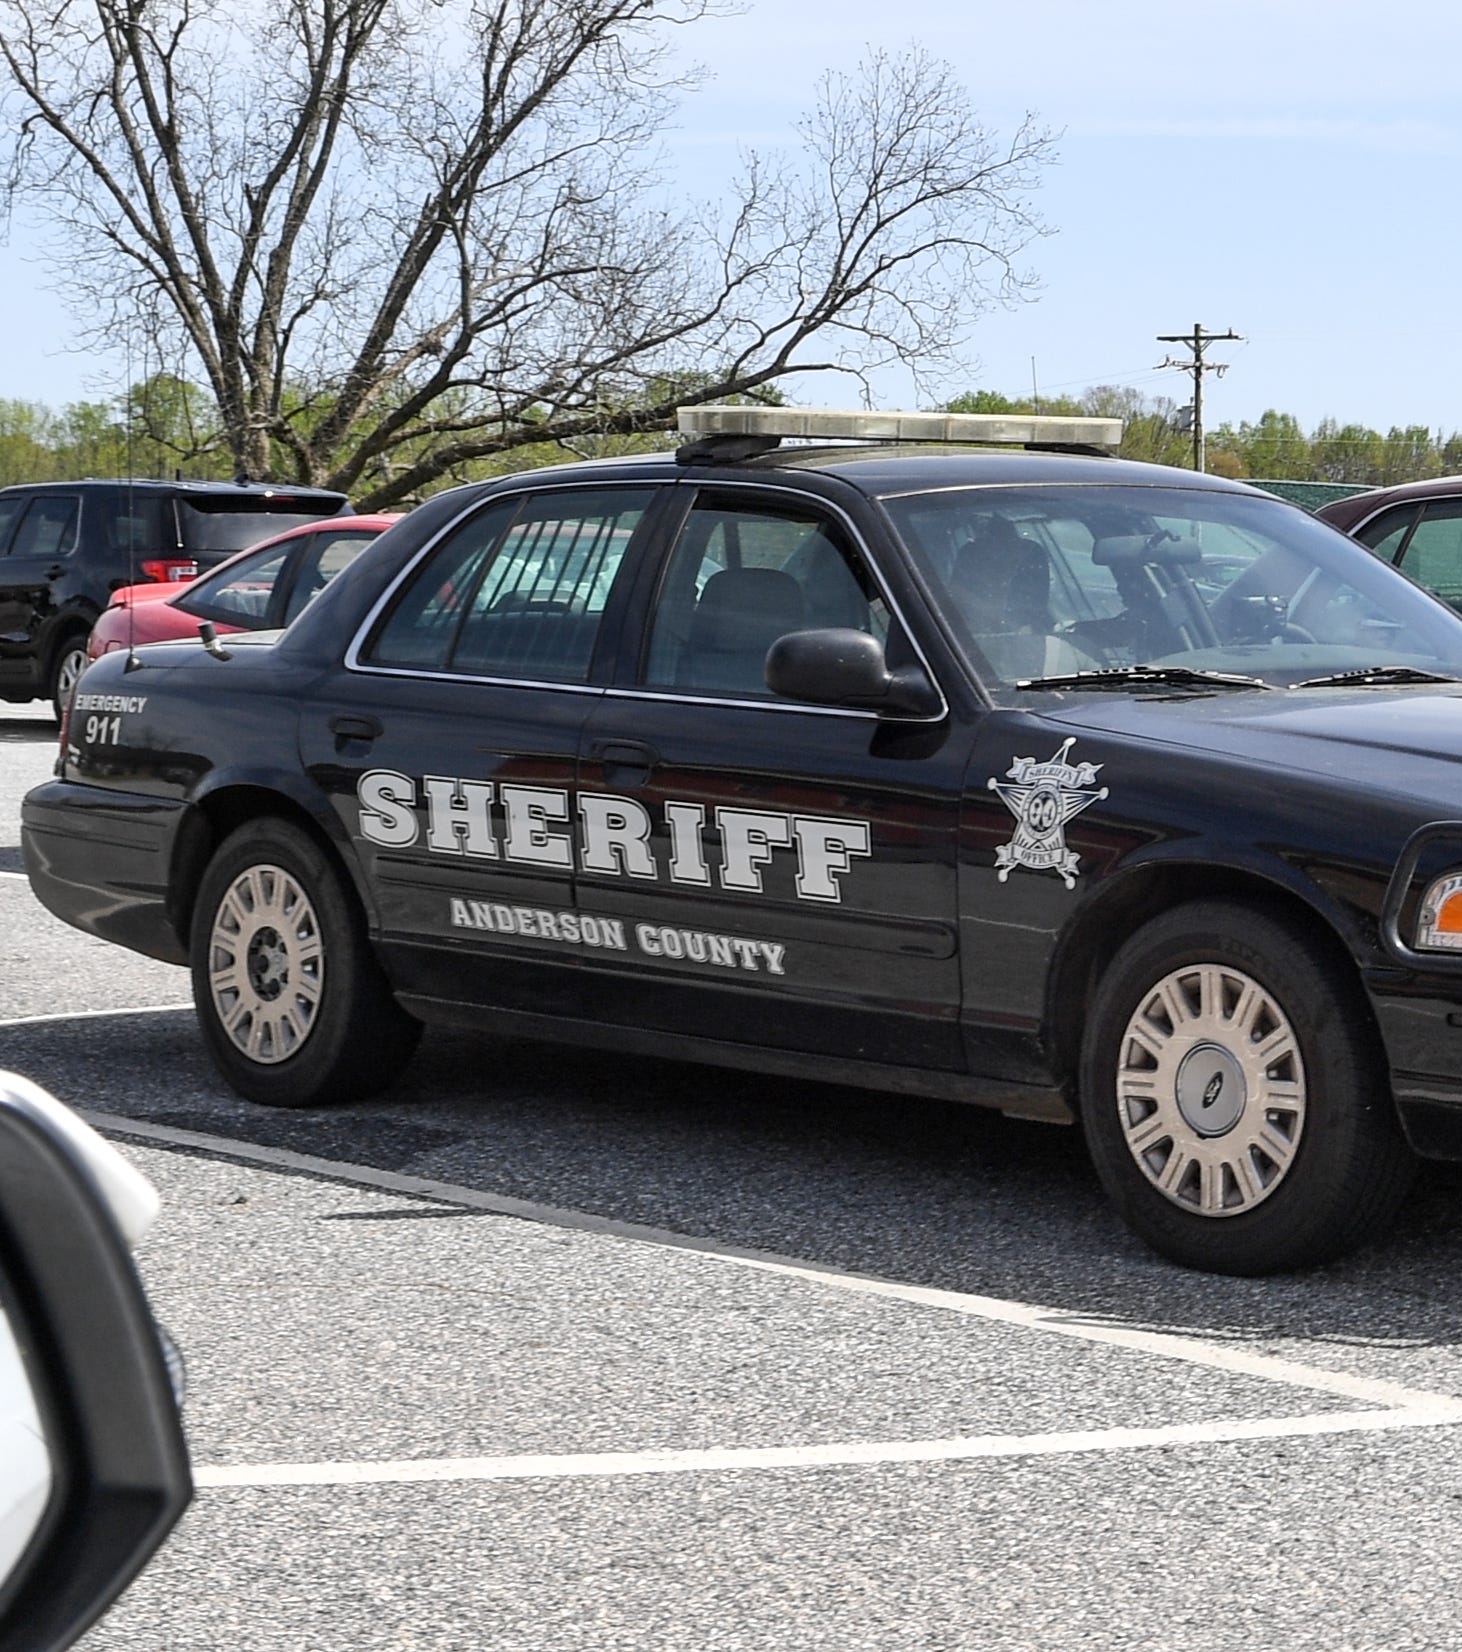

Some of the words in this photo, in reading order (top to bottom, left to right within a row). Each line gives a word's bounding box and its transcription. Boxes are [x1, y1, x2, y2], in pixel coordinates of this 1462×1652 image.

[75, 694, 148, 713] EMERGENCY
[85, 715, 121, 745] 911
[356, 768, 872, 904] SHERIFF
[449, 897, 628, 952] ANDERSON
[635, 923, 787, 976] COUNTY
